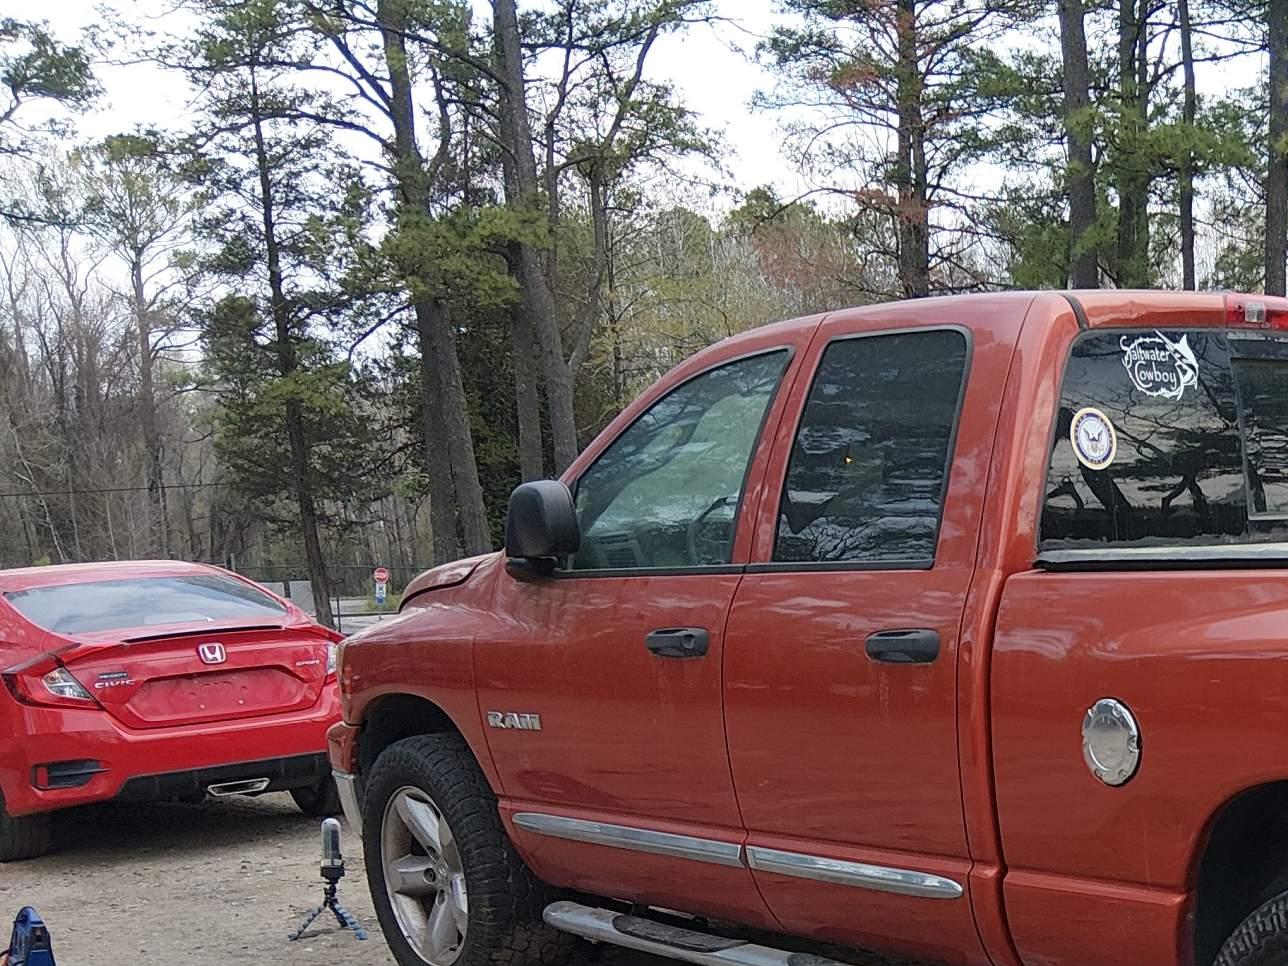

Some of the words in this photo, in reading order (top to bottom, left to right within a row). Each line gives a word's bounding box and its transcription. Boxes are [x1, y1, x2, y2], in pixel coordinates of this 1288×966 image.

[1119, 335, 1170, 368] Saltwater
[1134, 362, 1177, 389] Cowboy
[94, 679, 136, 689] CIVIC
[487, 711, 542, 731] RAM
